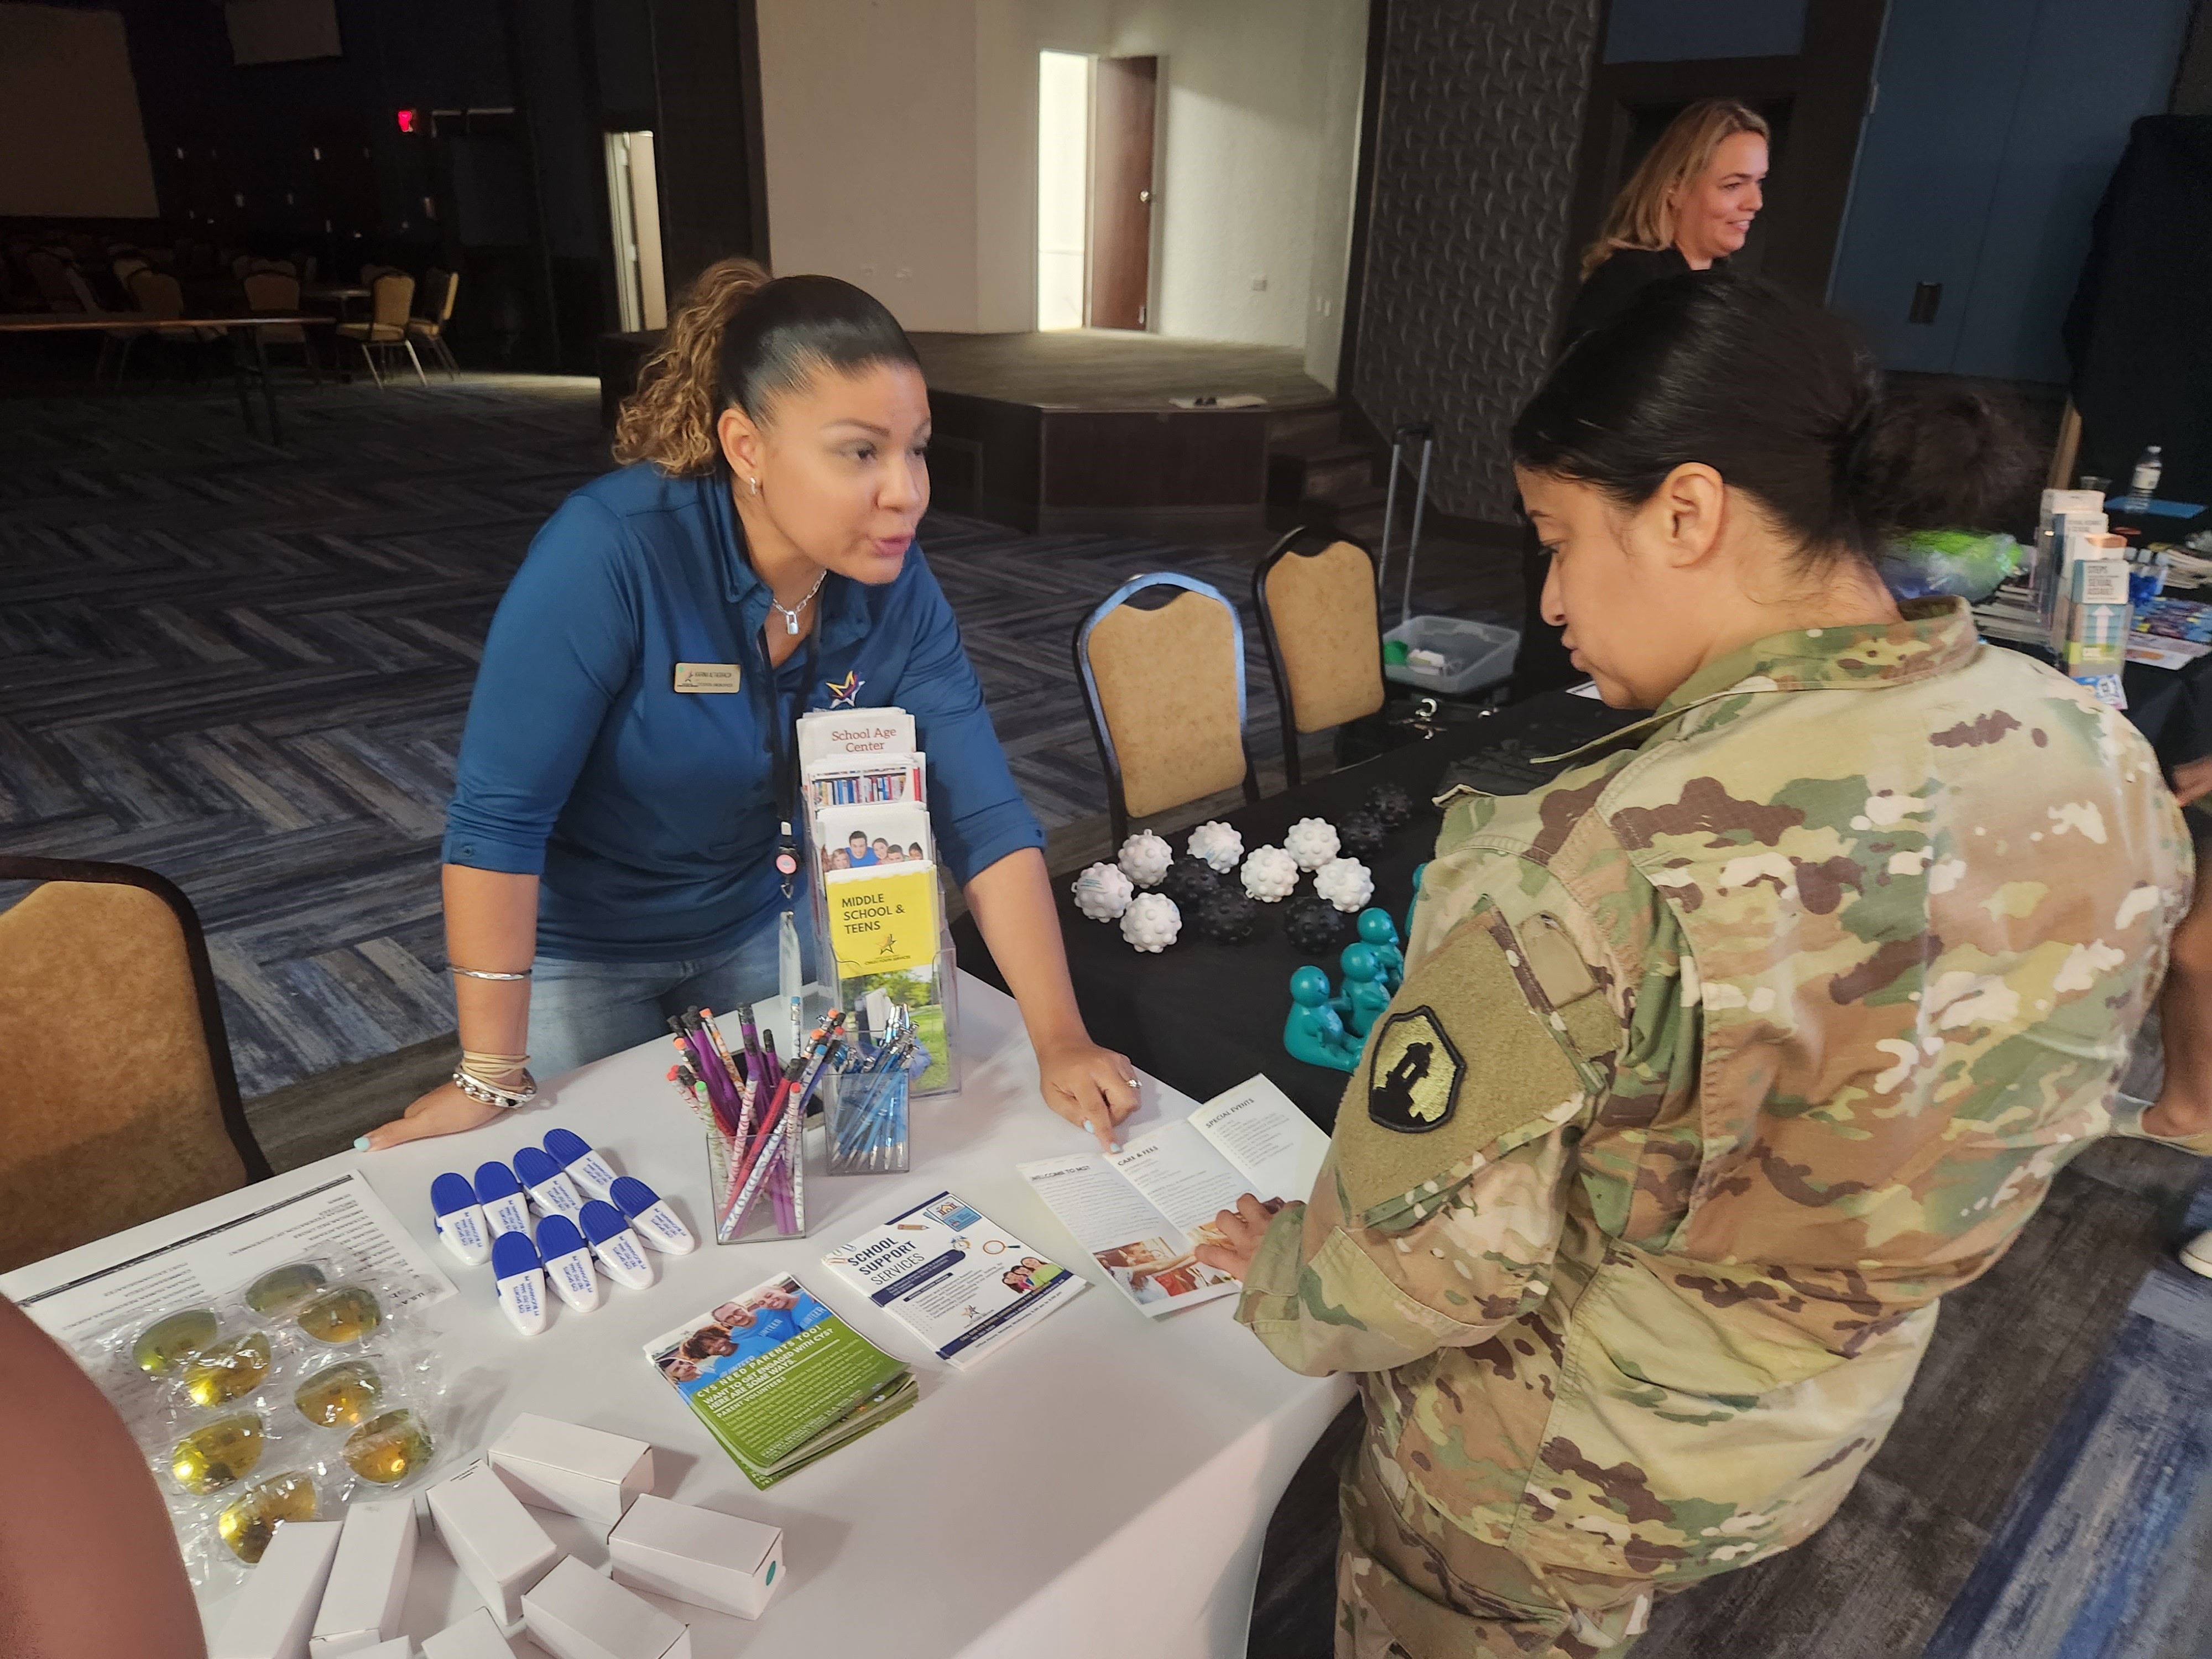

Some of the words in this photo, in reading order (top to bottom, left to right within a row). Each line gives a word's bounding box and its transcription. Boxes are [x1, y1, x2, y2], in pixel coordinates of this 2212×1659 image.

[832, 728, 870, 741] School
[874, 728, 896, 739] Age
[846, 742, 885, 753] Center
[842, 894, 884, 907] MIDDLE
[843, 906, 893, 921] SCHOOL
[896, 904, 905, 914] &
[844, 921, 880, 934] TEENS
[1205, 1110, 1230, 1128] SPECIAL
[1230, 1098, 1254, 1113] EVENTS
[1117, 1155, 1135, 1166] CARE
[848, 1237, 899, 1266] SCHOOL
[859, 1240, 917, 1275] SUPPORT
[870, 1253, 925, 1286] SERVICES
[758, 1318, 783, 1337] UNTEER
[697, 1385, 718, 1398] CYS
[719, 1368, 747, 1386] NEED
[749, 1339, 795, 1369] PARENTS
[796, 1324, 822, 1341] TOO!
[702, 1387, 729, 1405] WANT
[729, 1380, 743, 1390] TO
[741, 1371, 758, 1383] GET
[757, 1350, 795, 1374] ENGAGED
[792, 1338, 815, 1353] WITH
[813, 1327, 834, 1342] CYS?
[707, 1394, 732, 1410] HERE
[728, 1385, 747, 1398] ARE
[745, 1372, 771, 1389] SOME
[767, 1357, 797, 1376] WAYS.
[716, 1400, 745, 1418] PARENT
[743, 1375, 787, 1402] VOLUNTEERS
